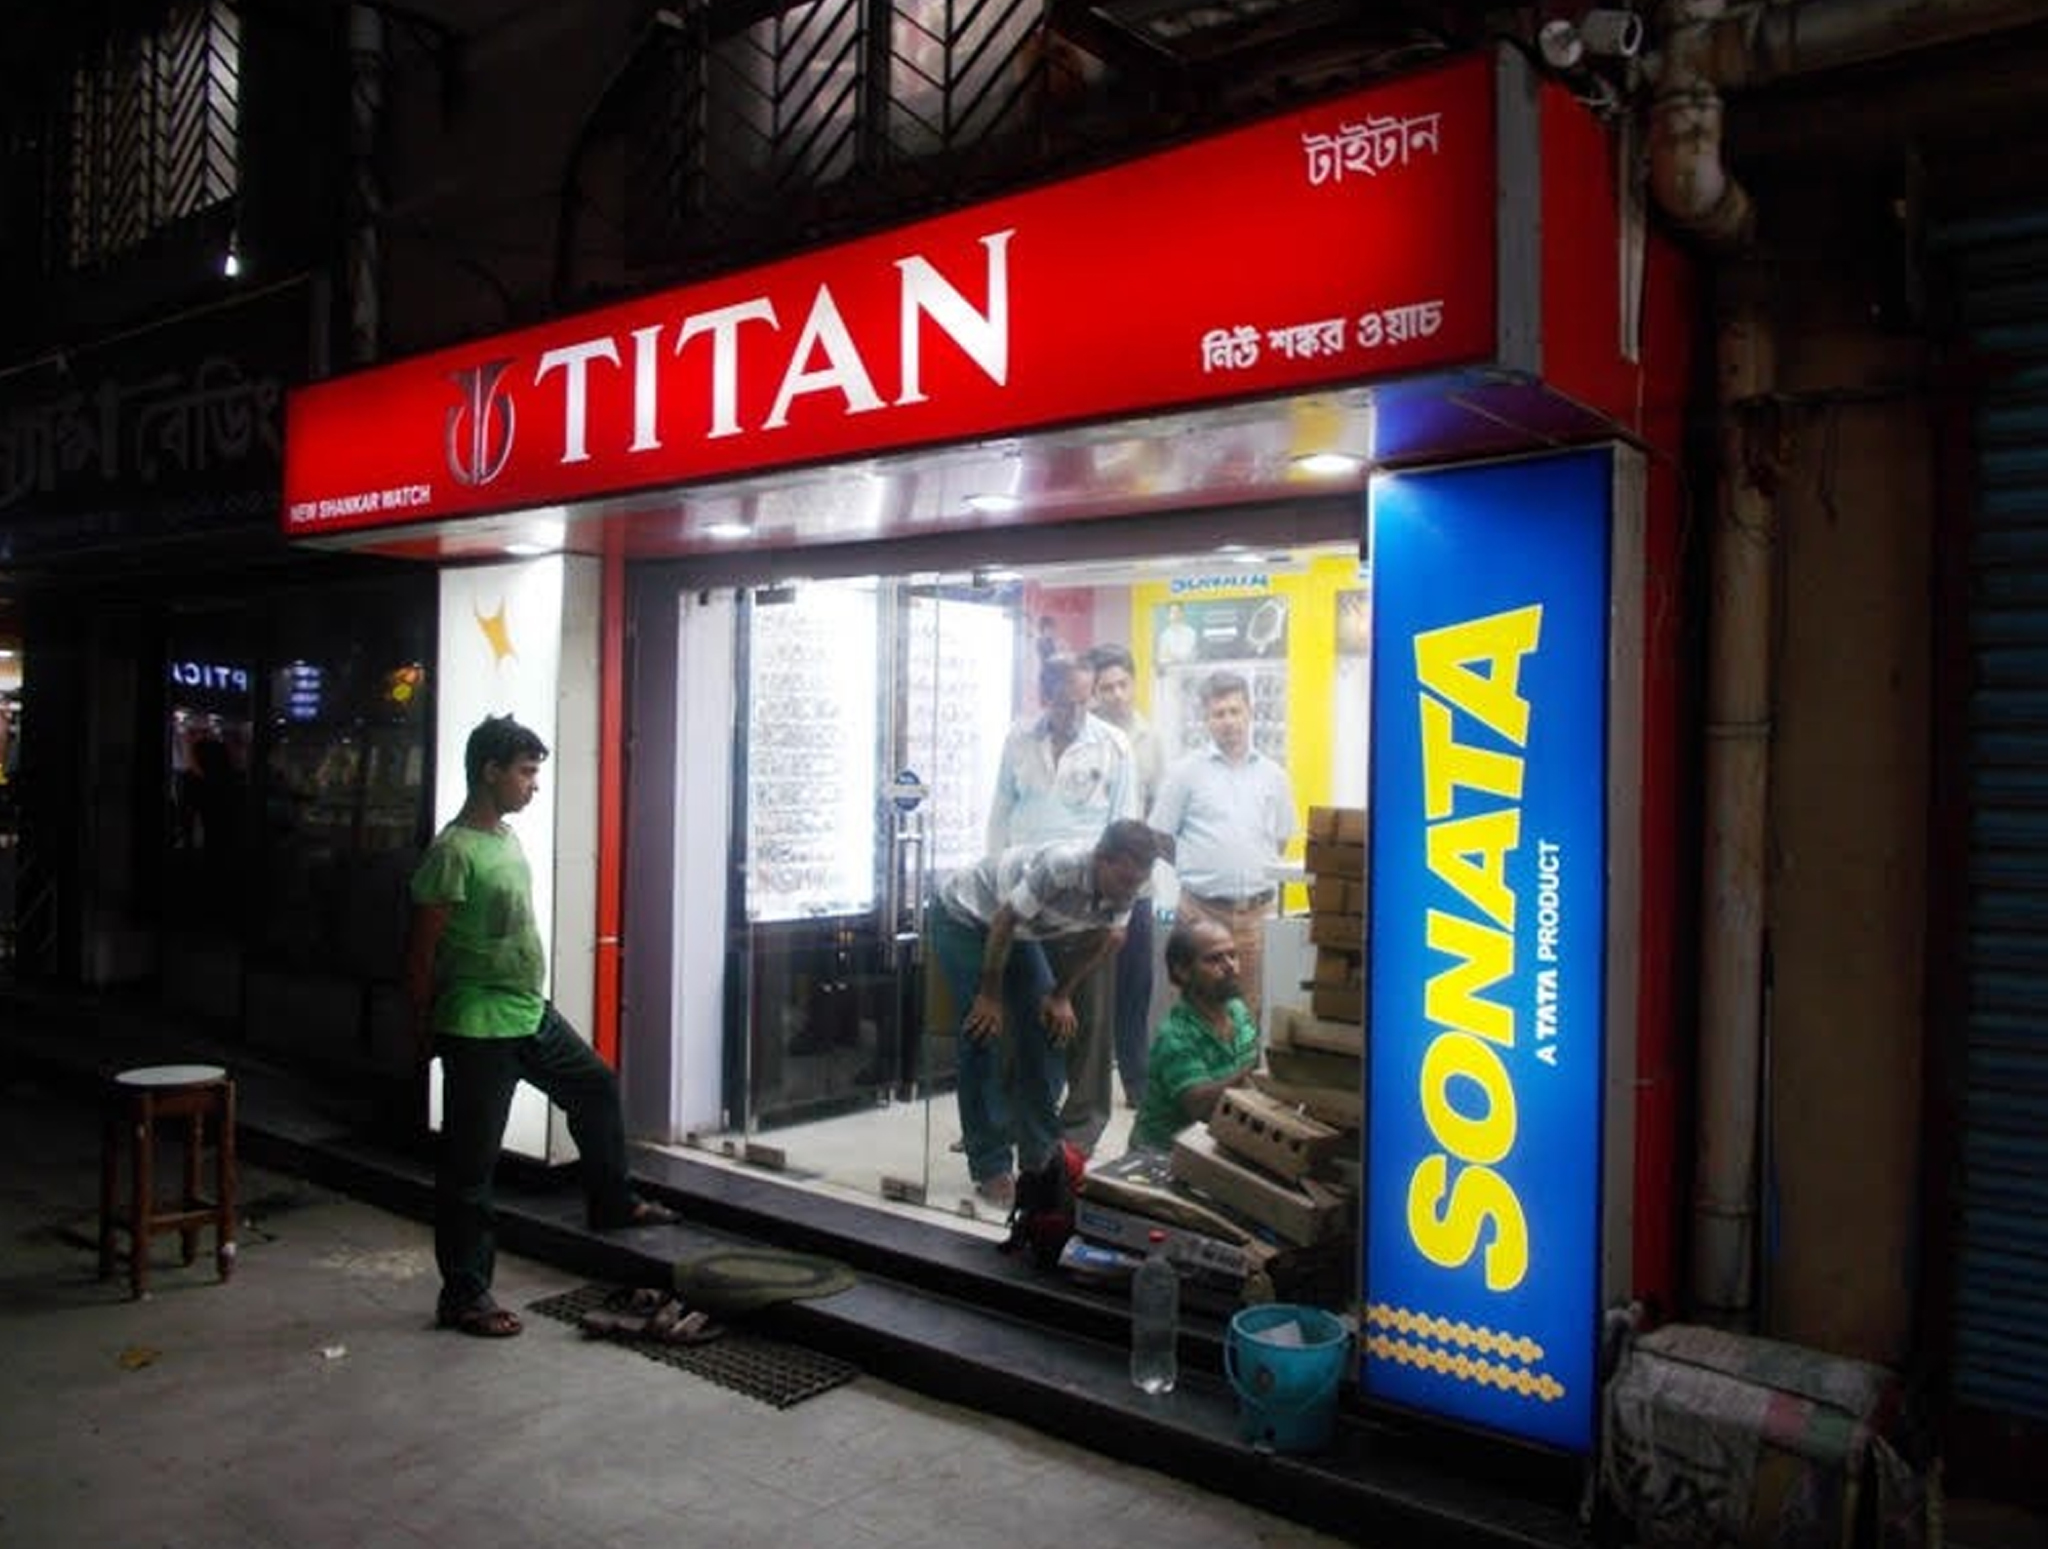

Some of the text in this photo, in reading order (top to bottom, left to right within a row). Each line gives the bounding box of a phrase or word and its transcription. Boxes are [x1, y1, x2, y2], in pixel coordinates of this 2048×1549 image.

[1303, 113, 1441, 186] টাইটান
[534, 229, 1016, 465] TITAN
[1201, 300, 1444, 373] নিউ শঙ্কর ওয়াচ
[290, 501, 317, 524] NEW
[319, 490, 380, 519] SHANKAR
[381, 484, 431, 511] WATCH
[1407, 603, 1544, 1292] SONATA
[1535, 838, 1561, 1066] A TATA PRODUCT
